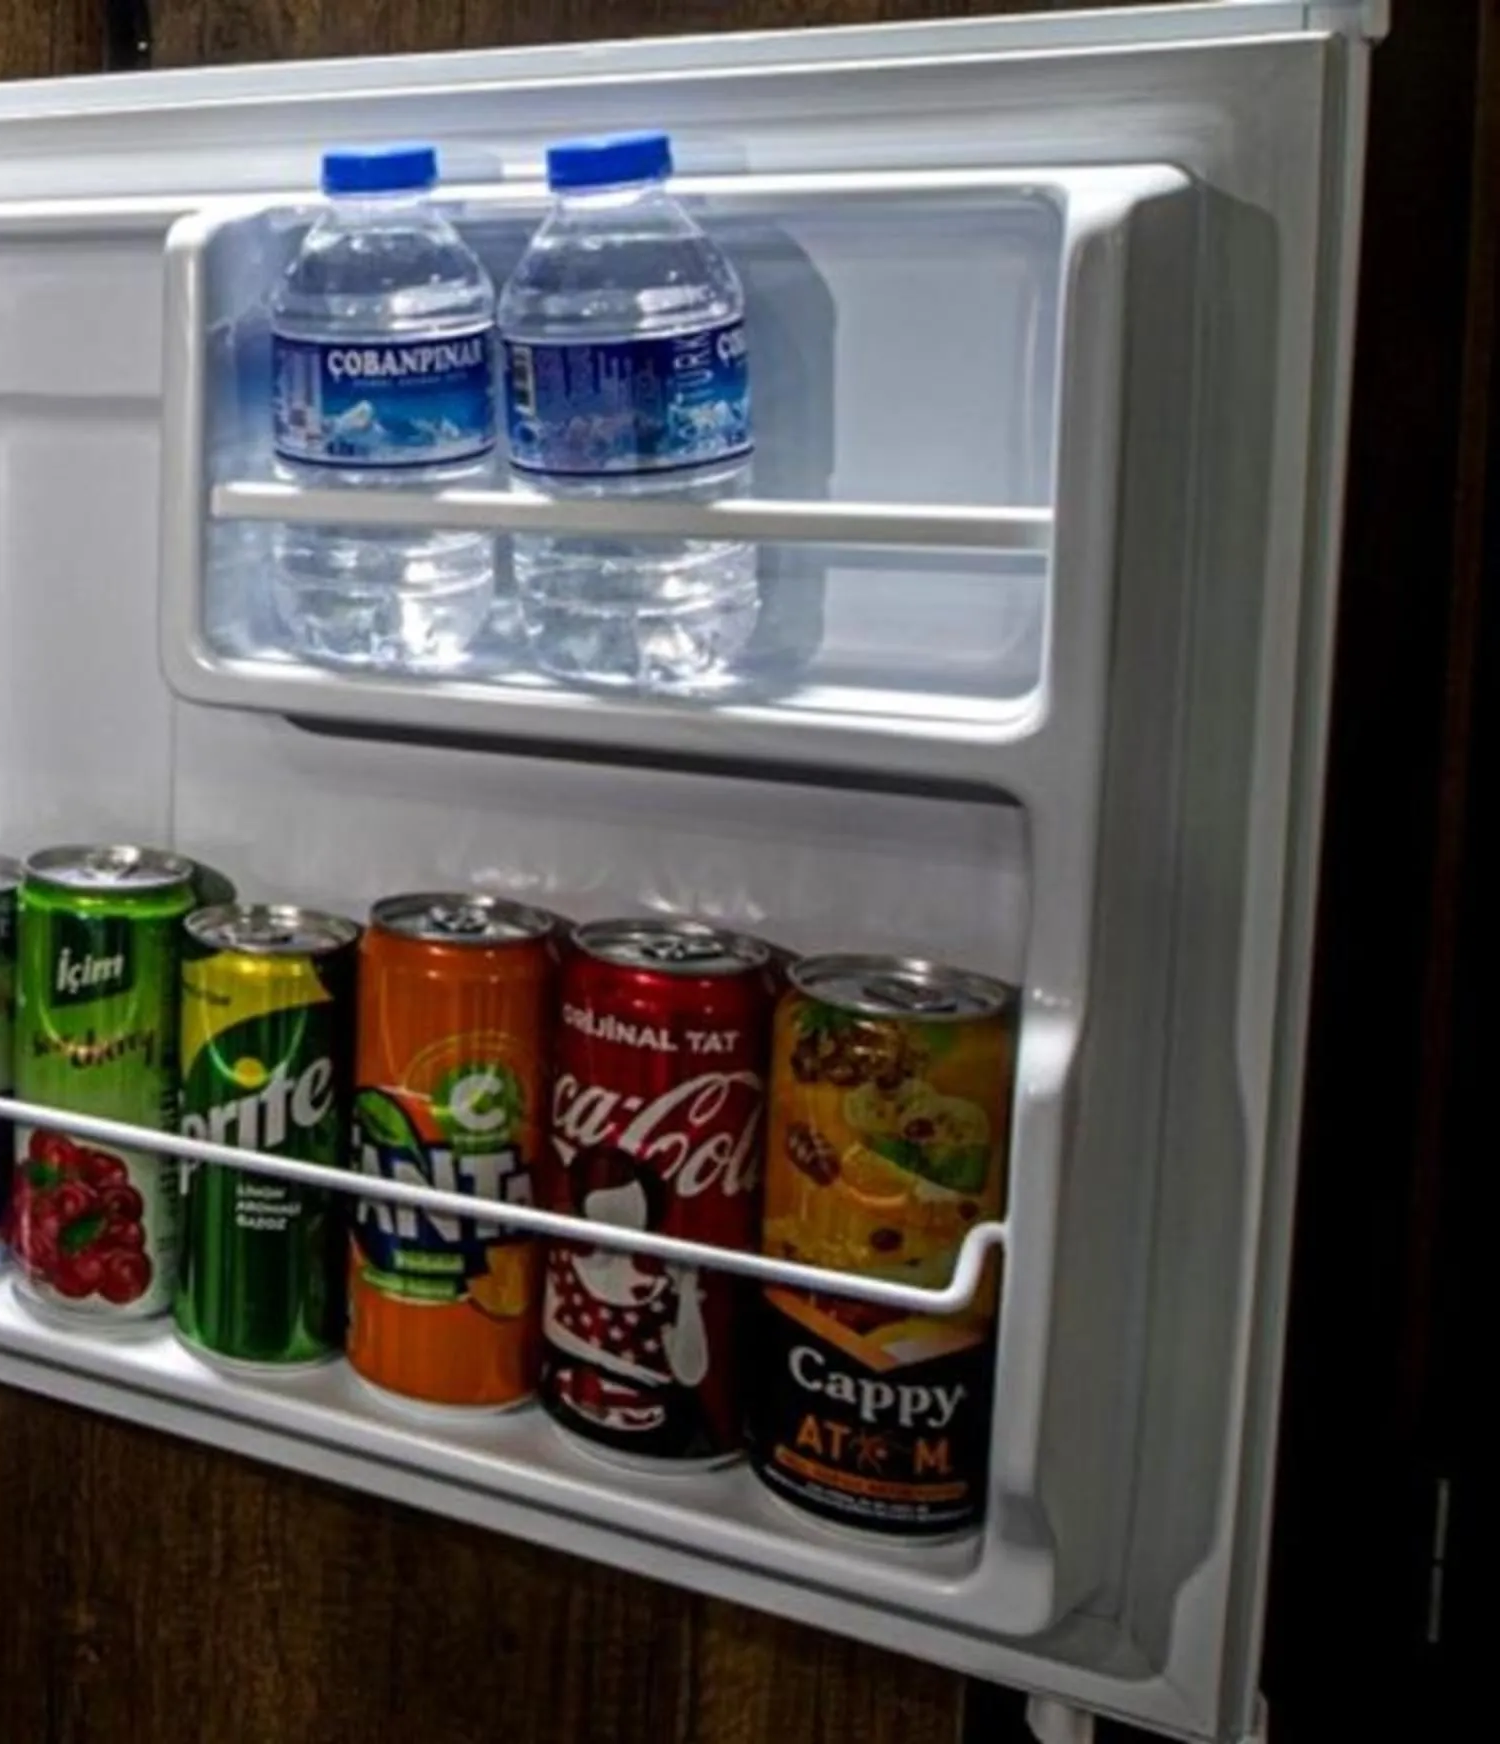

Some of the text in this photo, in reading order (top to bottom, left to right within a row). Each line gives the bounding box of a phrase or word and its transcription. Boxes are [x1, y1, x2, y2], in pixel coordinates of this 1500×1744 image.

[57, 948, 124, 993] İçim
[685, 1030, 741, 1054] TAT
[178, 1057, 334, 1195] prite
[449, 1073, 507, 1132] C
[552, 1071, 763, 1197] ca-Col
[354, 1143, 534, 1242] ANTA
[789, 1346, 964, 1427] Cappy
